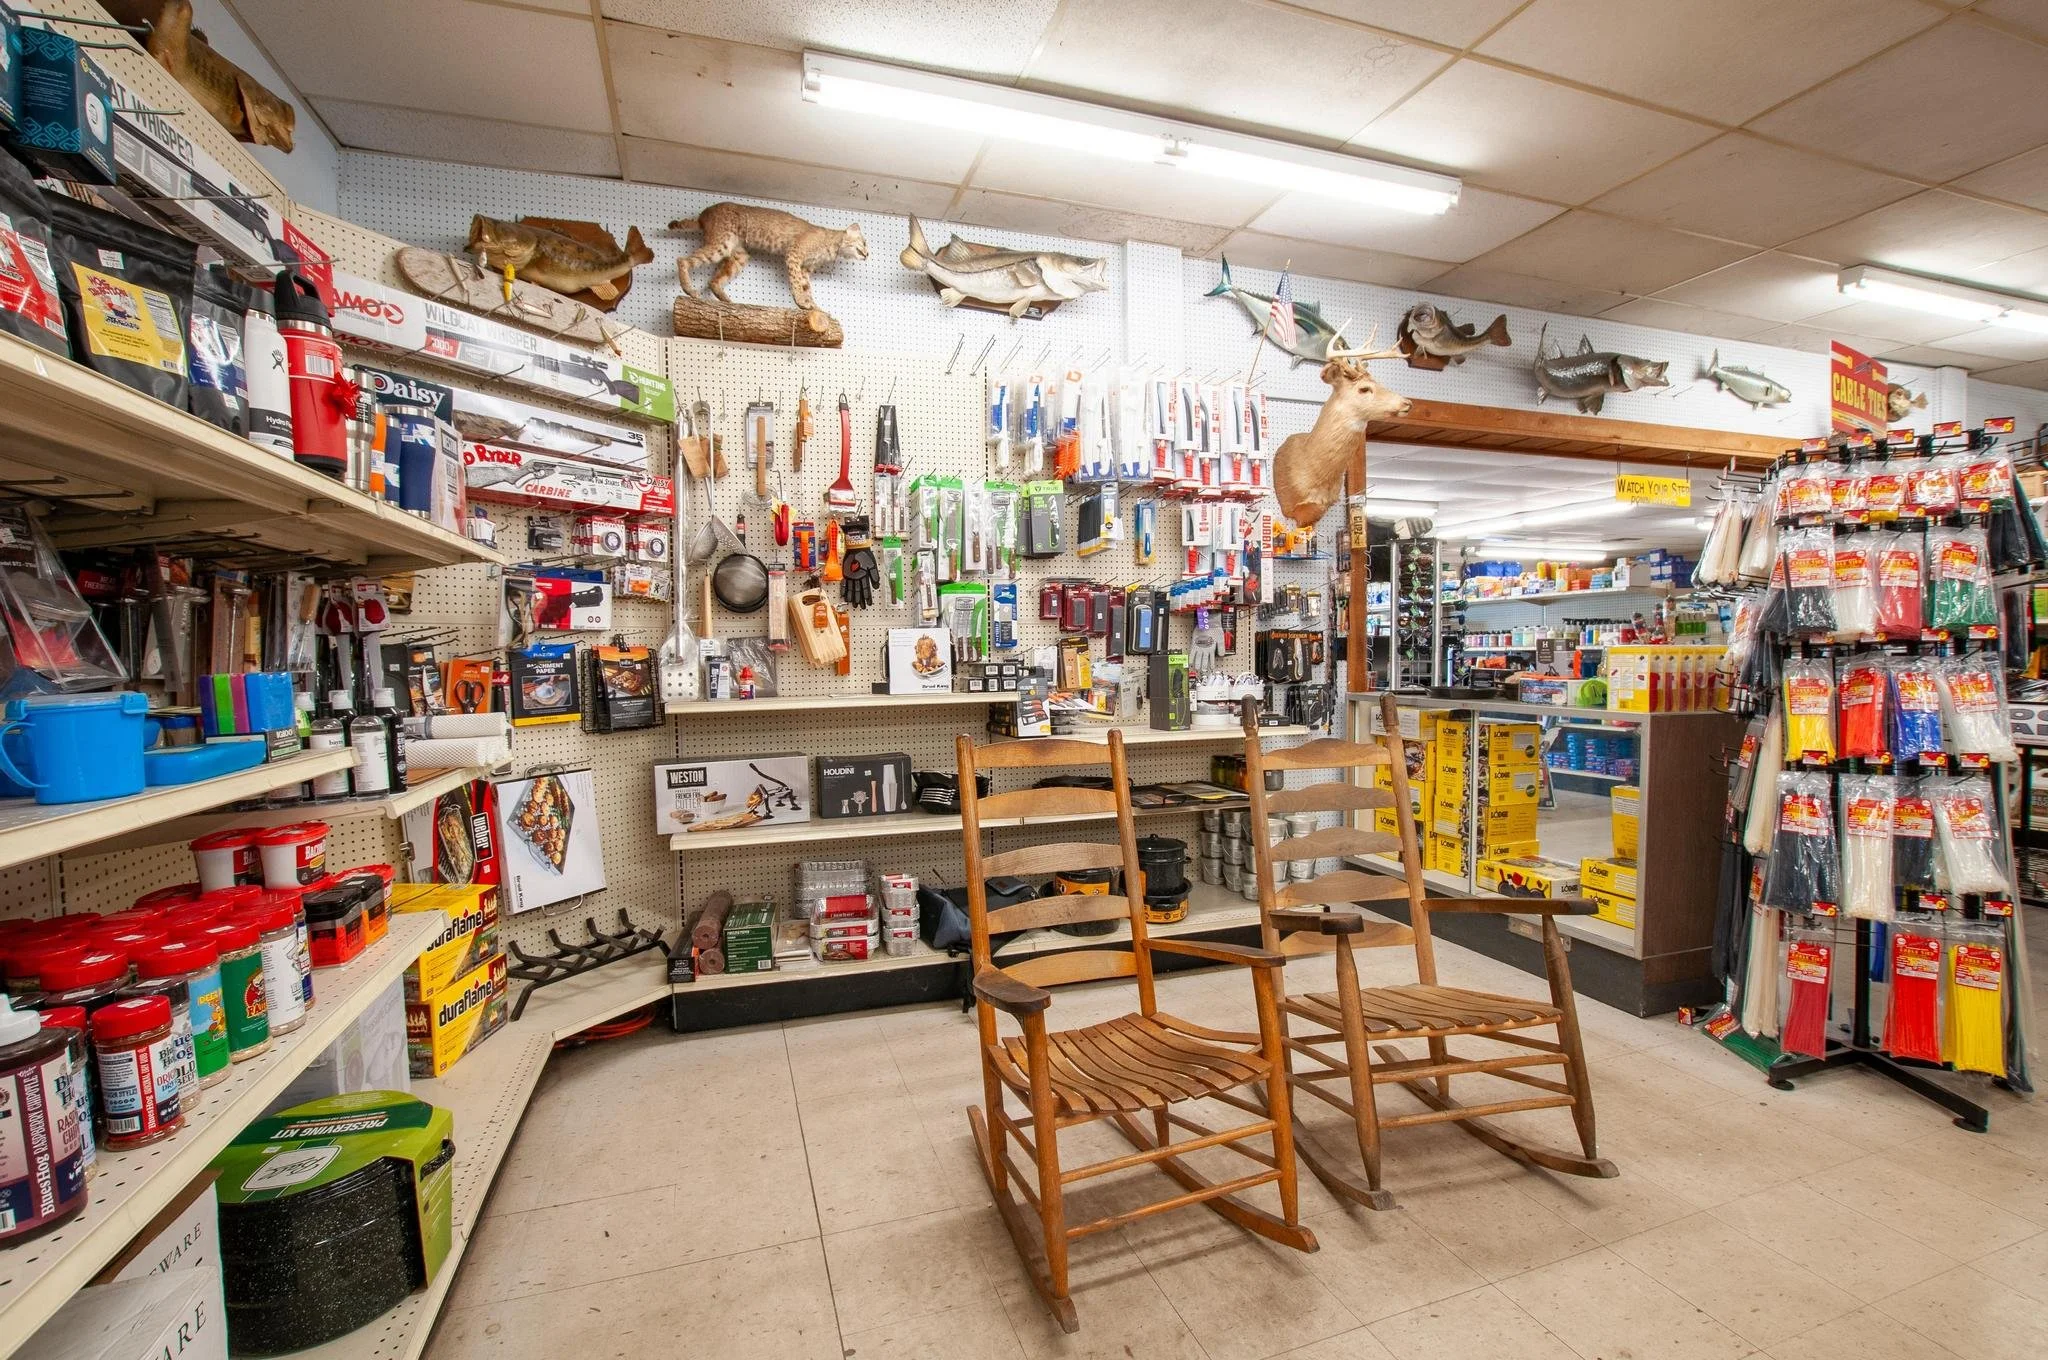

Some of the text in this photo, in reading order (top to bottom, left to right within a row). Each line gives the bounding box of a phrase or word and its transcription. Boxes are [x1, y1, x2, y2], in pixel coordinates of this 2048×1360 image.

[333, 288, 382, 318] AMO
[424, 302, 538, 352] WILDCAT WHISPER
[374, 371, 447, 410] Daisy
[1832, 371, 1888, 422] CABLE TIES
[473, 444, 523, 468] RYDER
[524, 482, 573, 499] CARBINE
[1617, 479, 1690, 496] WATCH YOUR STEP
[669, 769, 705, 785] WESTON
[823, 767, 855, 776] HOUDINI
[472, 816, 489, 849] weber
[1588, 865, 1609, 877] LODGE
[1561, 884, 1579, 893] LODGE
[438, 981, 492, 1028] duraflame
[270, 1118, 388, 1140] PRESERVING KIT
[23, 1074, 56, 1218] BluesHog RASPBERRY CHIPOTLE
[149, 1221, 203, 1276] WARE
[154, 1300, 207, 1360] ARE
